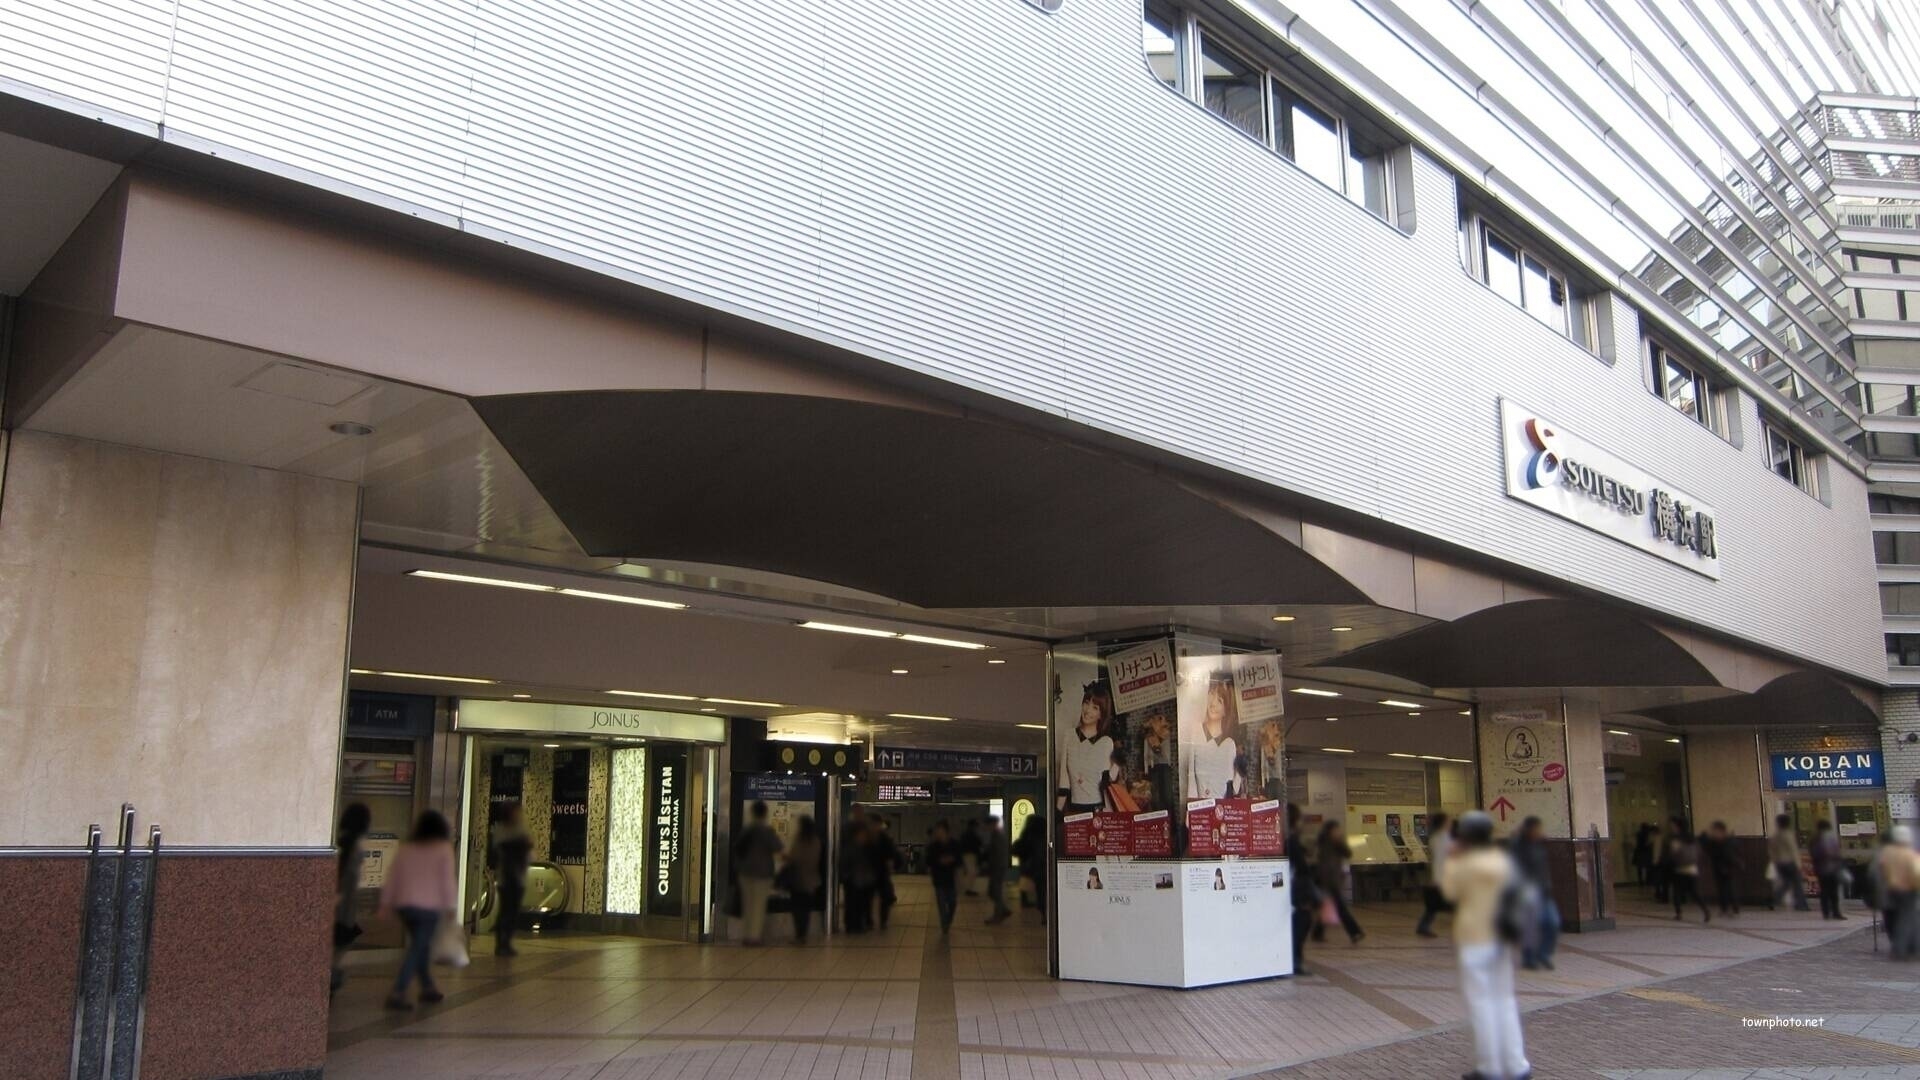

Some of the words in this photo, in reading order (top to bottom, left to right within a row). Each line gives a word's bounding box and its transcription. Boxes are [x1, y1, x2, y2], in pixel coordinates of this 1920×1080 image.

[1562, 458, 1646, 515] SOTETSU
[1651, 488, 1717, 559] 横浜駅
[1115, 652, 1166, 681] リサコレ
[375, 709, 398, 719] ATM
[587, 711, 640, 729] JOINUS
[1784, 754, 1871, 770] KOBAN
[1809, 770, 1847, 778] POLICE
[658, 766, 672, 825] ISETAN
[671, 799, 679, 861] YOKOHAMA
[658, 826, 671, 895] QUEEN'S
